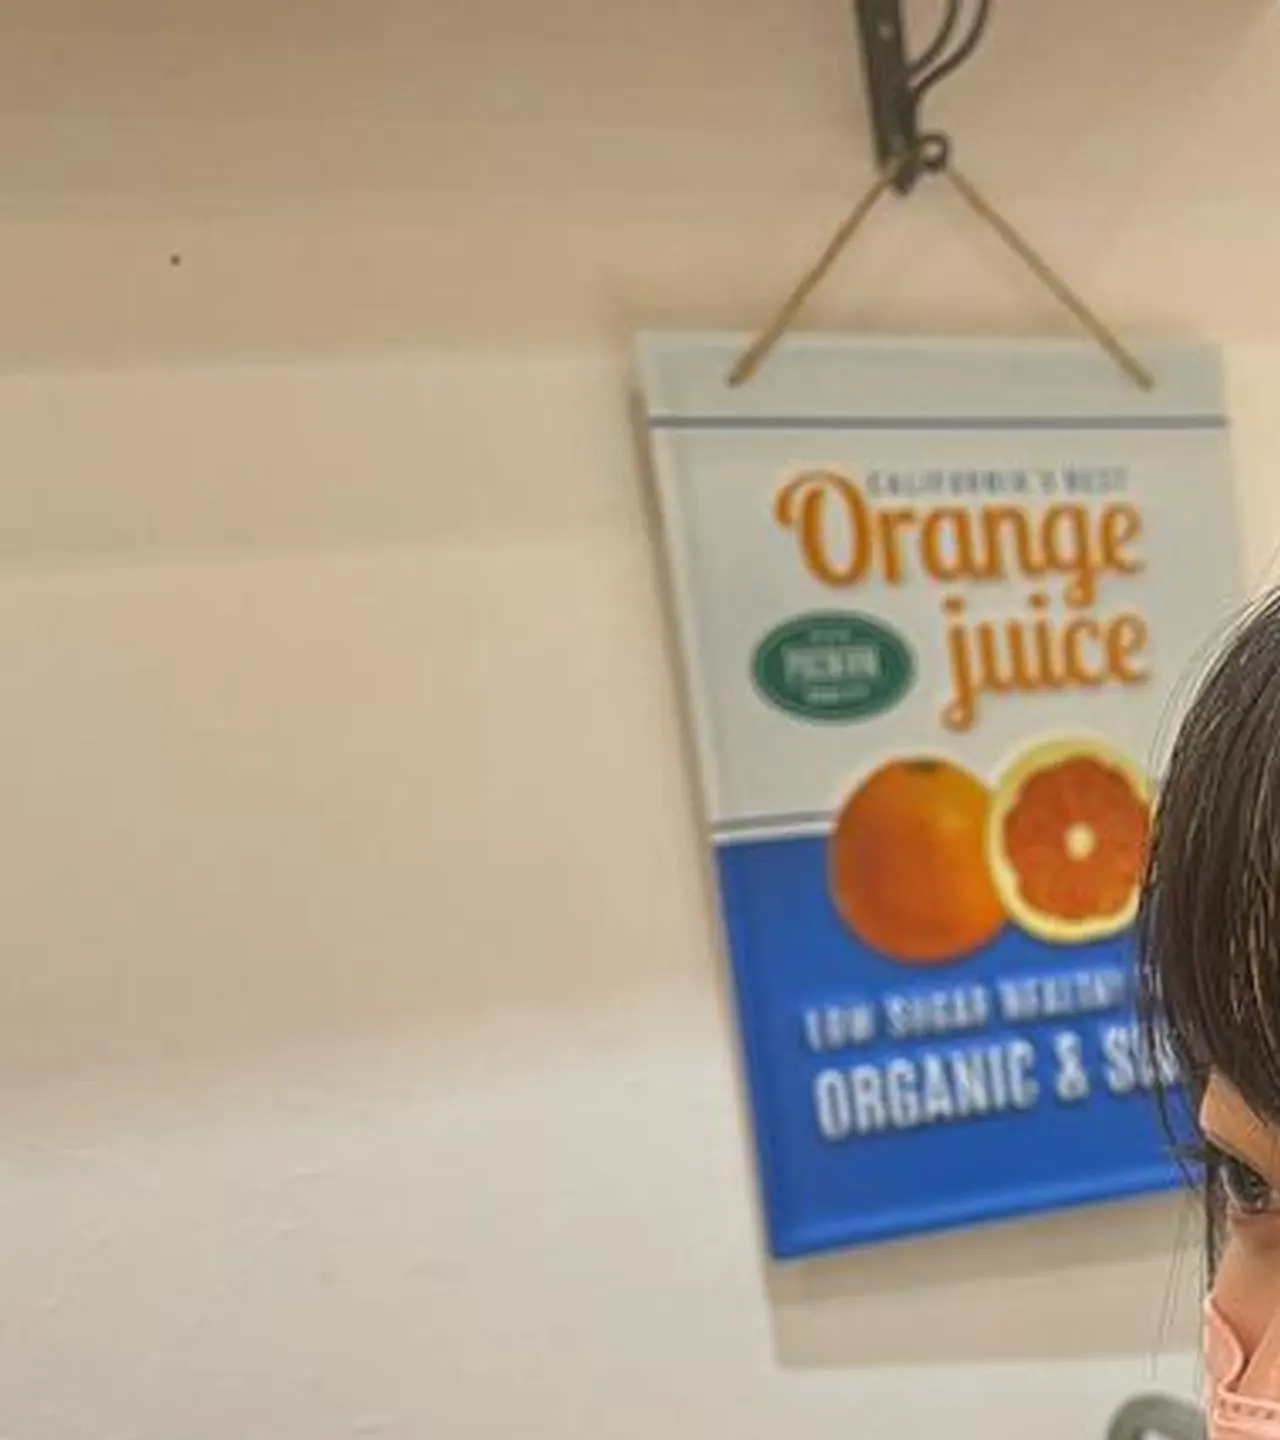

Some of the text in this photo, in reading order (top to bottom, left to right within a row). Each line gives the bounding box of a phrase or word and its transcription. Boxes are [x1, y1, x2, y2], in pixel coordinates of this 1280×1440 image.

[774, 463, 1146, 606] Orange
[942, 592, 1149, 732] juice
[805, 1000, 877, 1053] LOW
[885, 982, 990, 1039] SUGAR
[814, 1038, 1040, 1142] ORGANIC
[1053, 1029, 1091, 1102] &
